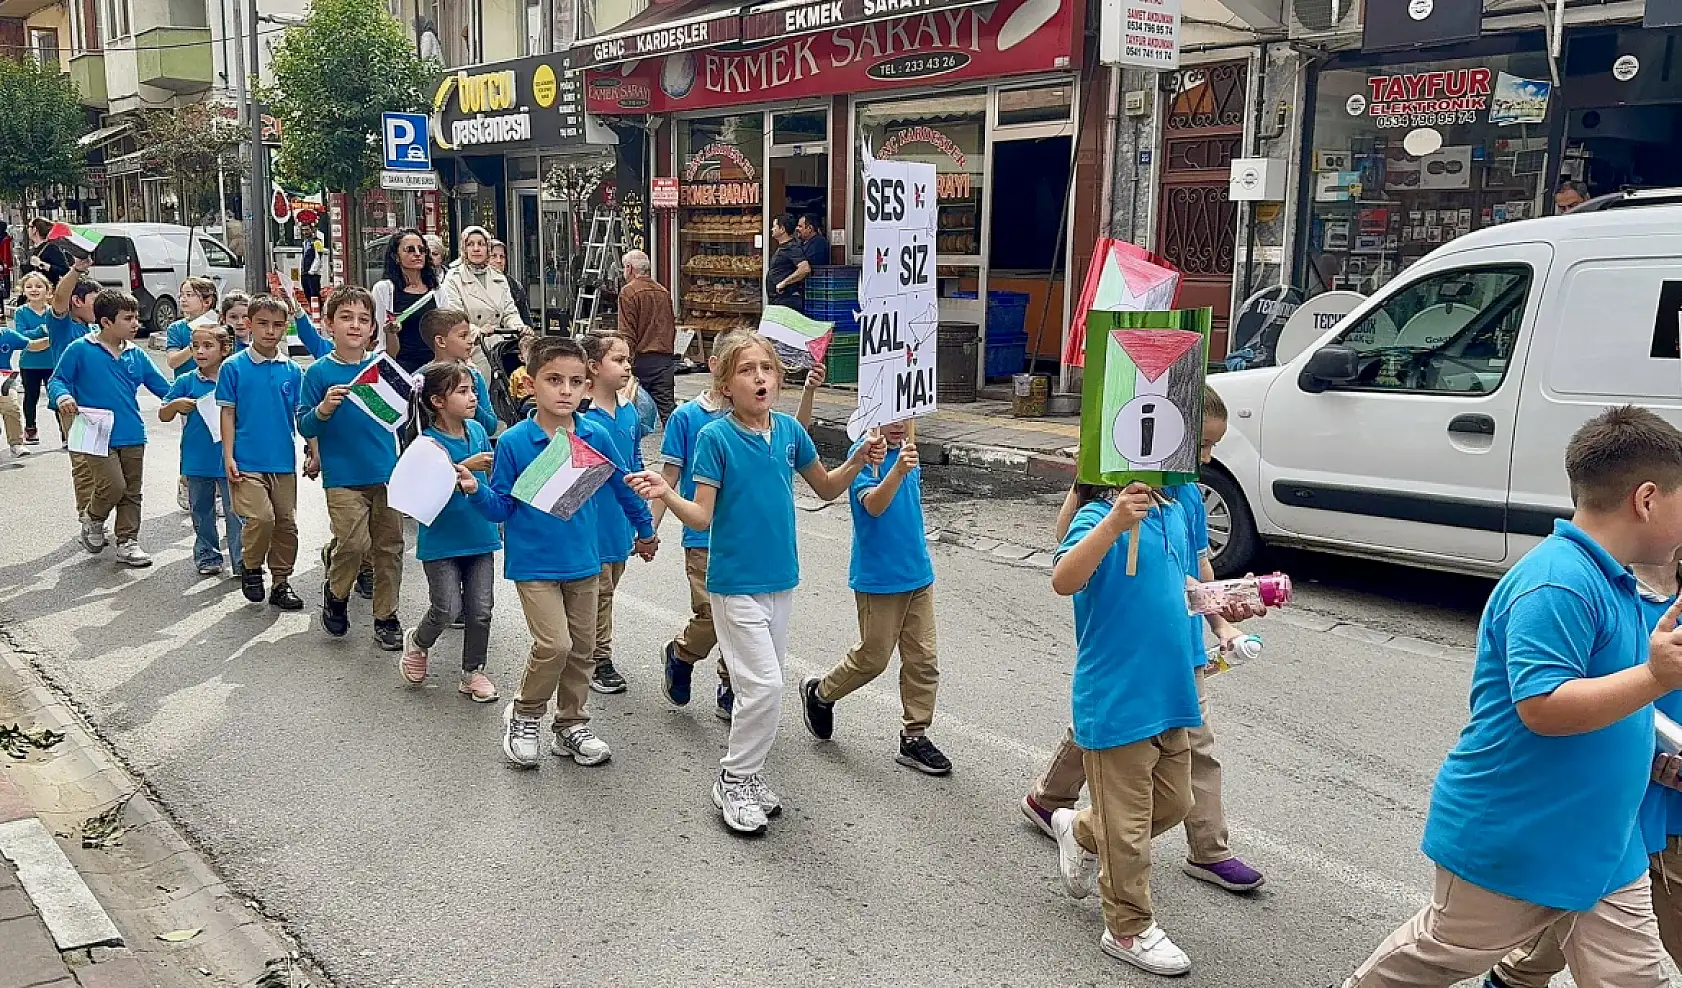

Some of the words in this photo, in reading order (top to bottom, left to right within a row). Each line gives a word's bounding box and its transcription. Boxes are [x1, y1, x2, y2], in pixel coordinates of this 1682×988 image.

[786, 2, 842, 32] EKMEK
[1127, 8, 1146, 20] SAMET
[1127, 20, 1142, 32] 0534
[1165, 26, 1173, 35] 74
[594, 39, 625, 61] GENÇ
[637, 22, 708, 52] KARDEŞLER
[705, 35, 822, 93] EKMEK
[830, 8, 982, 67] SARAYI
[1126, 34, 1146, 46] TAYFUR
[1126, 46, 1141, 57] 0541
[1142, 48, 1153, 59] 741
[1155, 50, 1163, 59] 11
[1164, 51, 1172, 60] 74
[880, 64, 896, 75] TEL
[905, 59, 924, 72] 233
[926, 57, 939, 69] 43
[942, 55, 956, 67] 26
[1368, 68, 1492, 101] TAYFUR
[457, 70, 517, 114] burcu
[1369, 95, 1486, 116] ELEKTRONİK
[386, 118, 415, 160] P
[452, 106, 531, 150] pastanesi
[1377, 115, 1409, 128] 0534
[1411, 113, 1436, 126] 796
[1437, 112, 1455, 125] 95
[1458, 111, 1476, 123] 74
[866, 178, 905, 222] SES
[899, 235, 928, 286] SİZ
[861, 310, 904, 357] KAL
[896, 367, 934, 412] MA!
[1140, 403, 1156, 457] i
